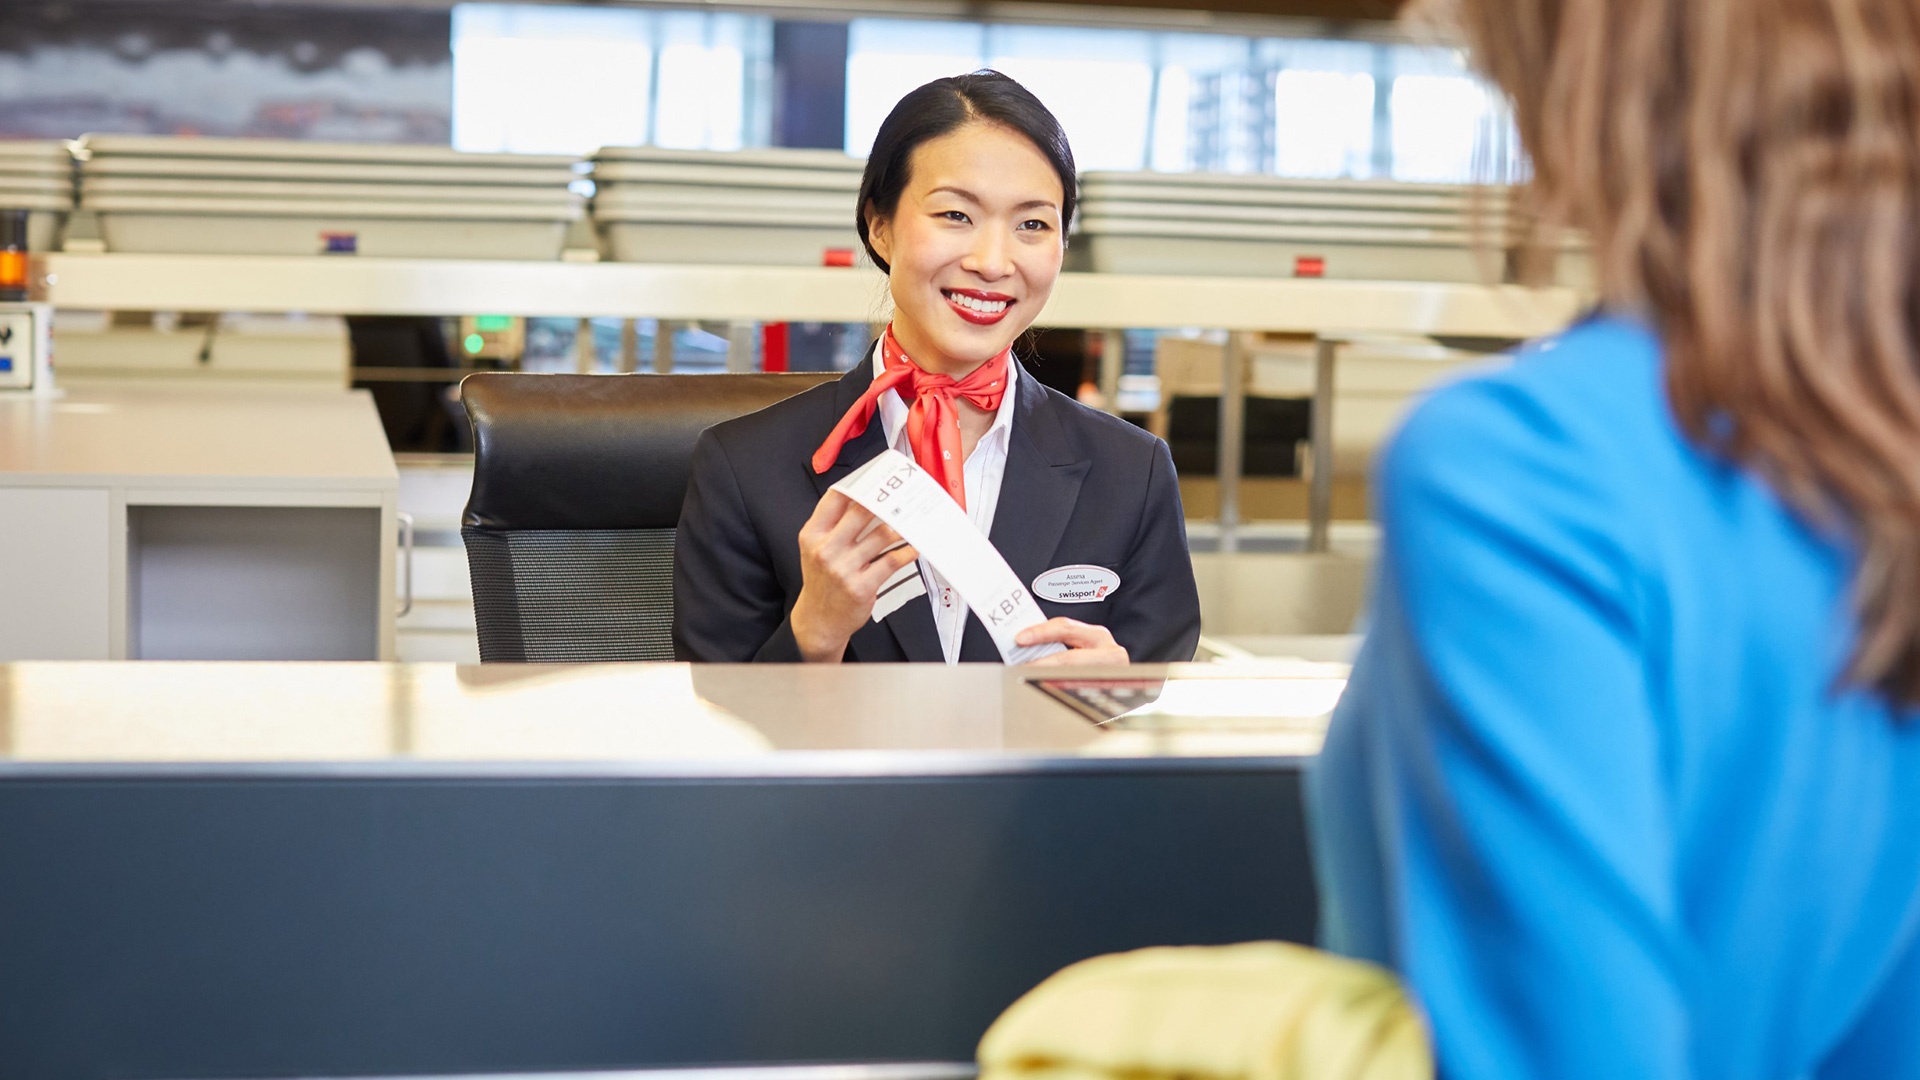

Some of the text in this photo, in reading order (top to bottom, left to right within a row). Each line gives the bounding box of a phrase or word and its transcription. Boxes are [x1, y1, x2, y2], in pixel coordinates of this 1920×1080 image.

[876, 462, 917, 503] KBP
[988, 589, 1022, 626] KBP
[1058, 589, 1096, 599] swissport
